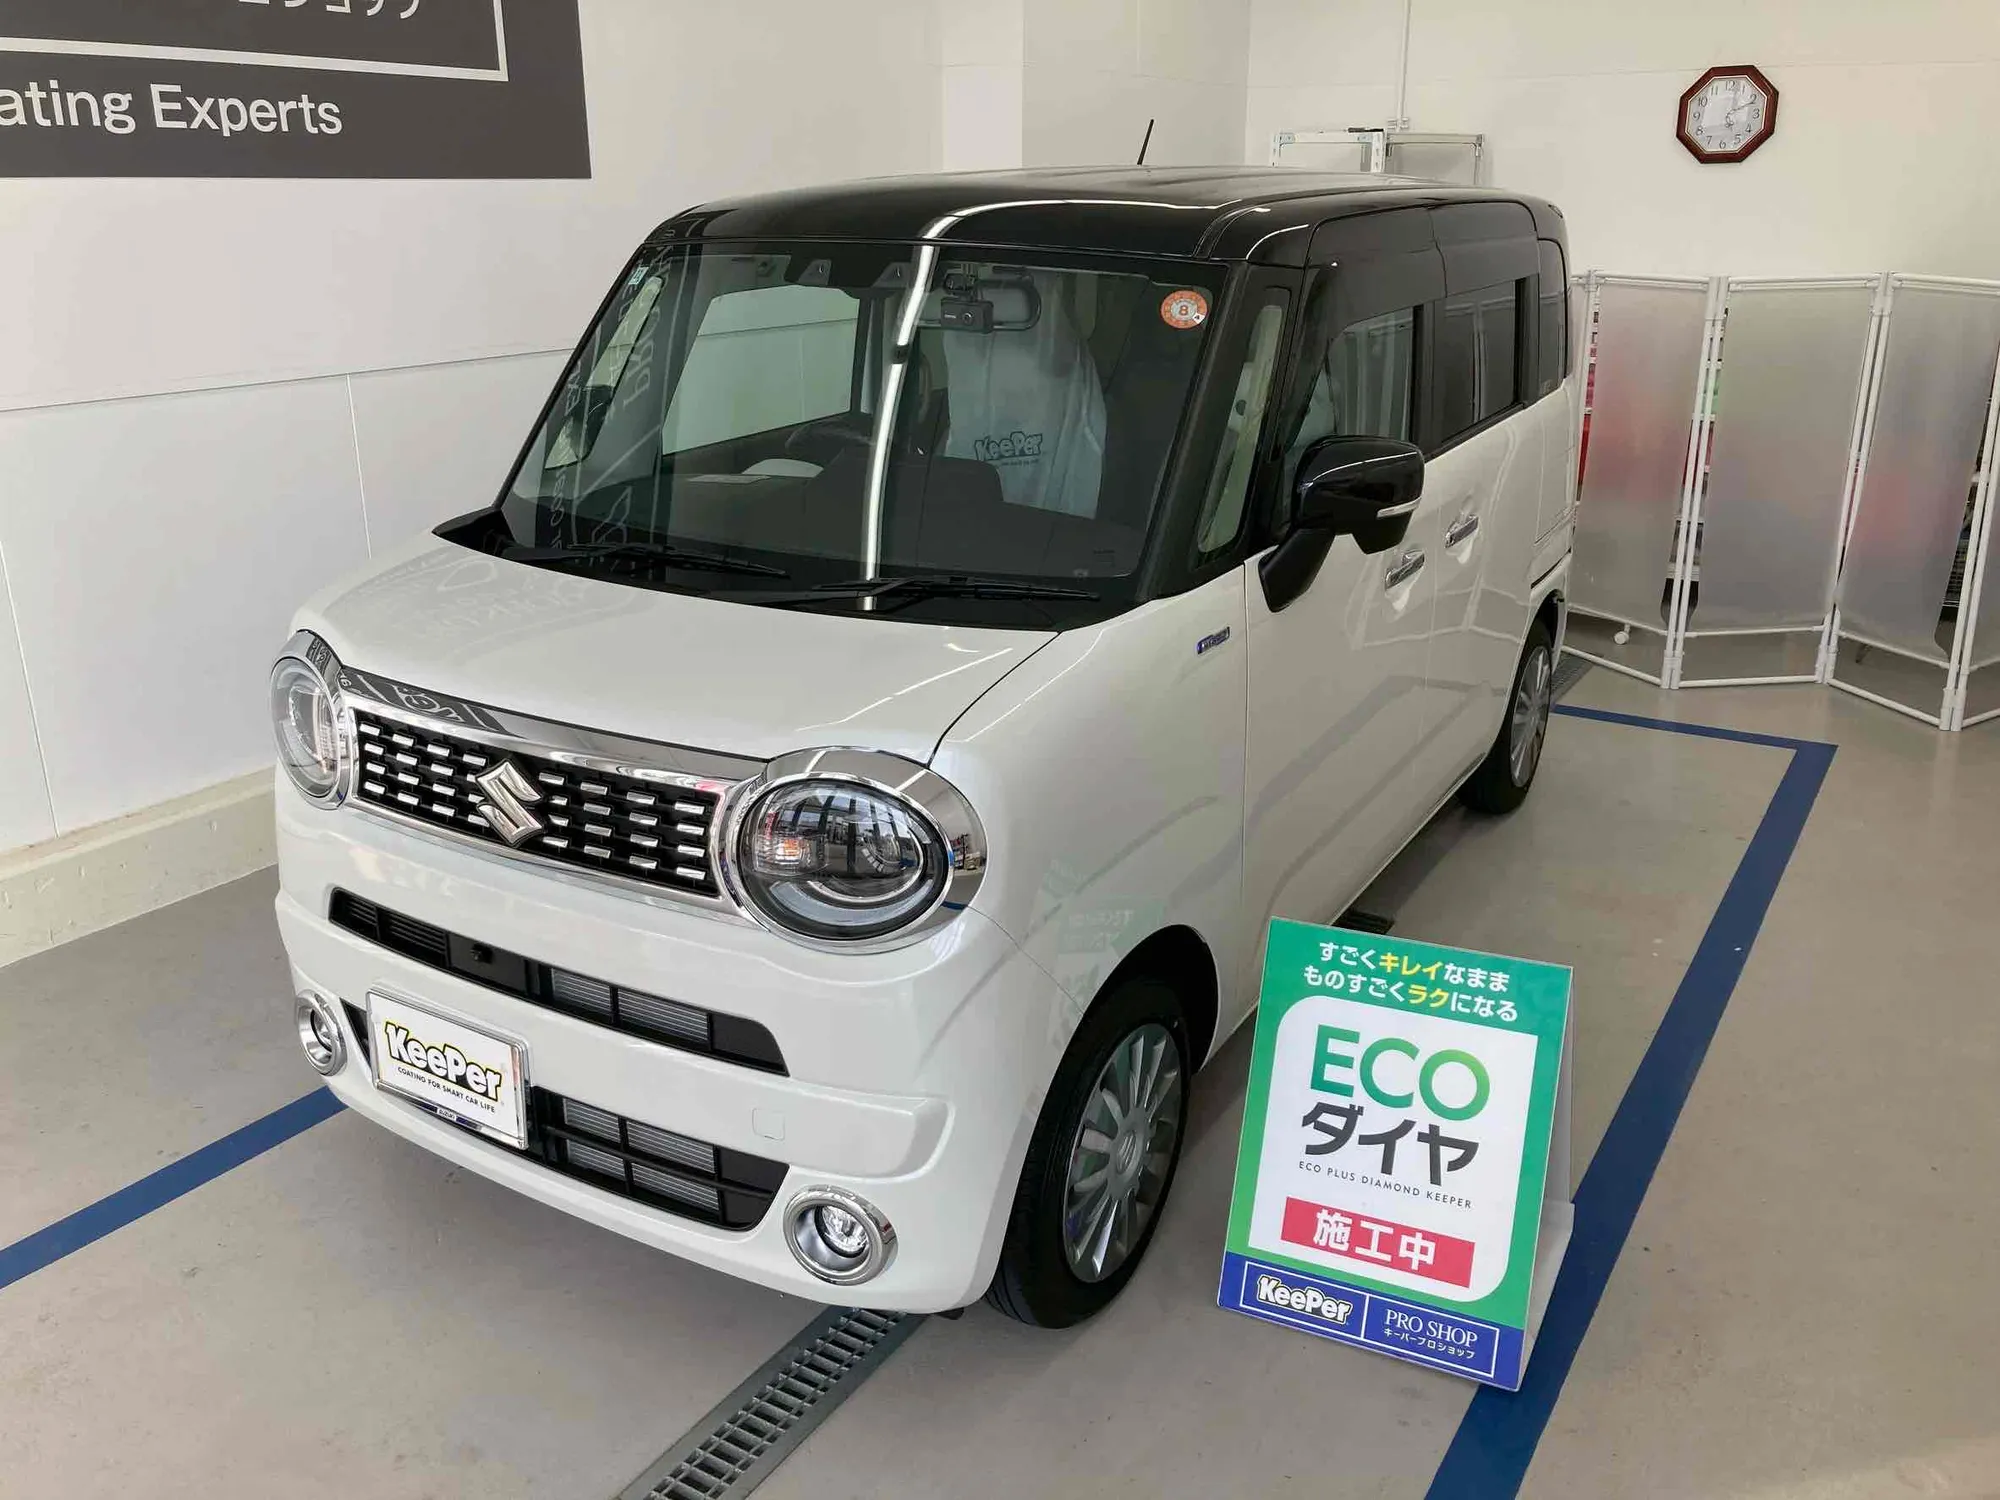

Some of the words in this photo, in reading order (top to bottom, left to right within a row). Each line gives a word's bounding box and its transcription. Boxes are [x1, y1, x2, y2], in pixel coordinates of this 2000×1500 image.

[0, 80, 136, 134] ating
[150, 83, 343, 137] Experts
[1304, 965, 1518, 1022] ものすごくラクになる
[1319, 942, 1510, 993] すごくキレイなまま
[385, 1021, 503, 1102] KeePer
[397, 1067, 426, 1083] COATING
[428, 1079, 441, 1089] FOR
[442, 1085, 464, 1099] SMART
[465, 1095, 479, 1105] CAR
[480, 1102, 495, 1113] LIFE
[1310, 1024, 1491, 1122] ECO
[1301, 1100, 1480, 1187] ダイヤ
[1299, 1161, 1322, 1173] ECO
[1327, 1167, 1356, 1182] PLUS
[1361, 1175, 1420, 1196] DIAMOND
[1426, 1190, 1472, 1209] KEEPER
[1313, 1209, 1438, 1272] 施工中
[1257, 1273, 1353, 1326] KeePer
[1385, 1308, 1424, 1333] PRO
[1426, 1321, 1478, 1348] SHOP
